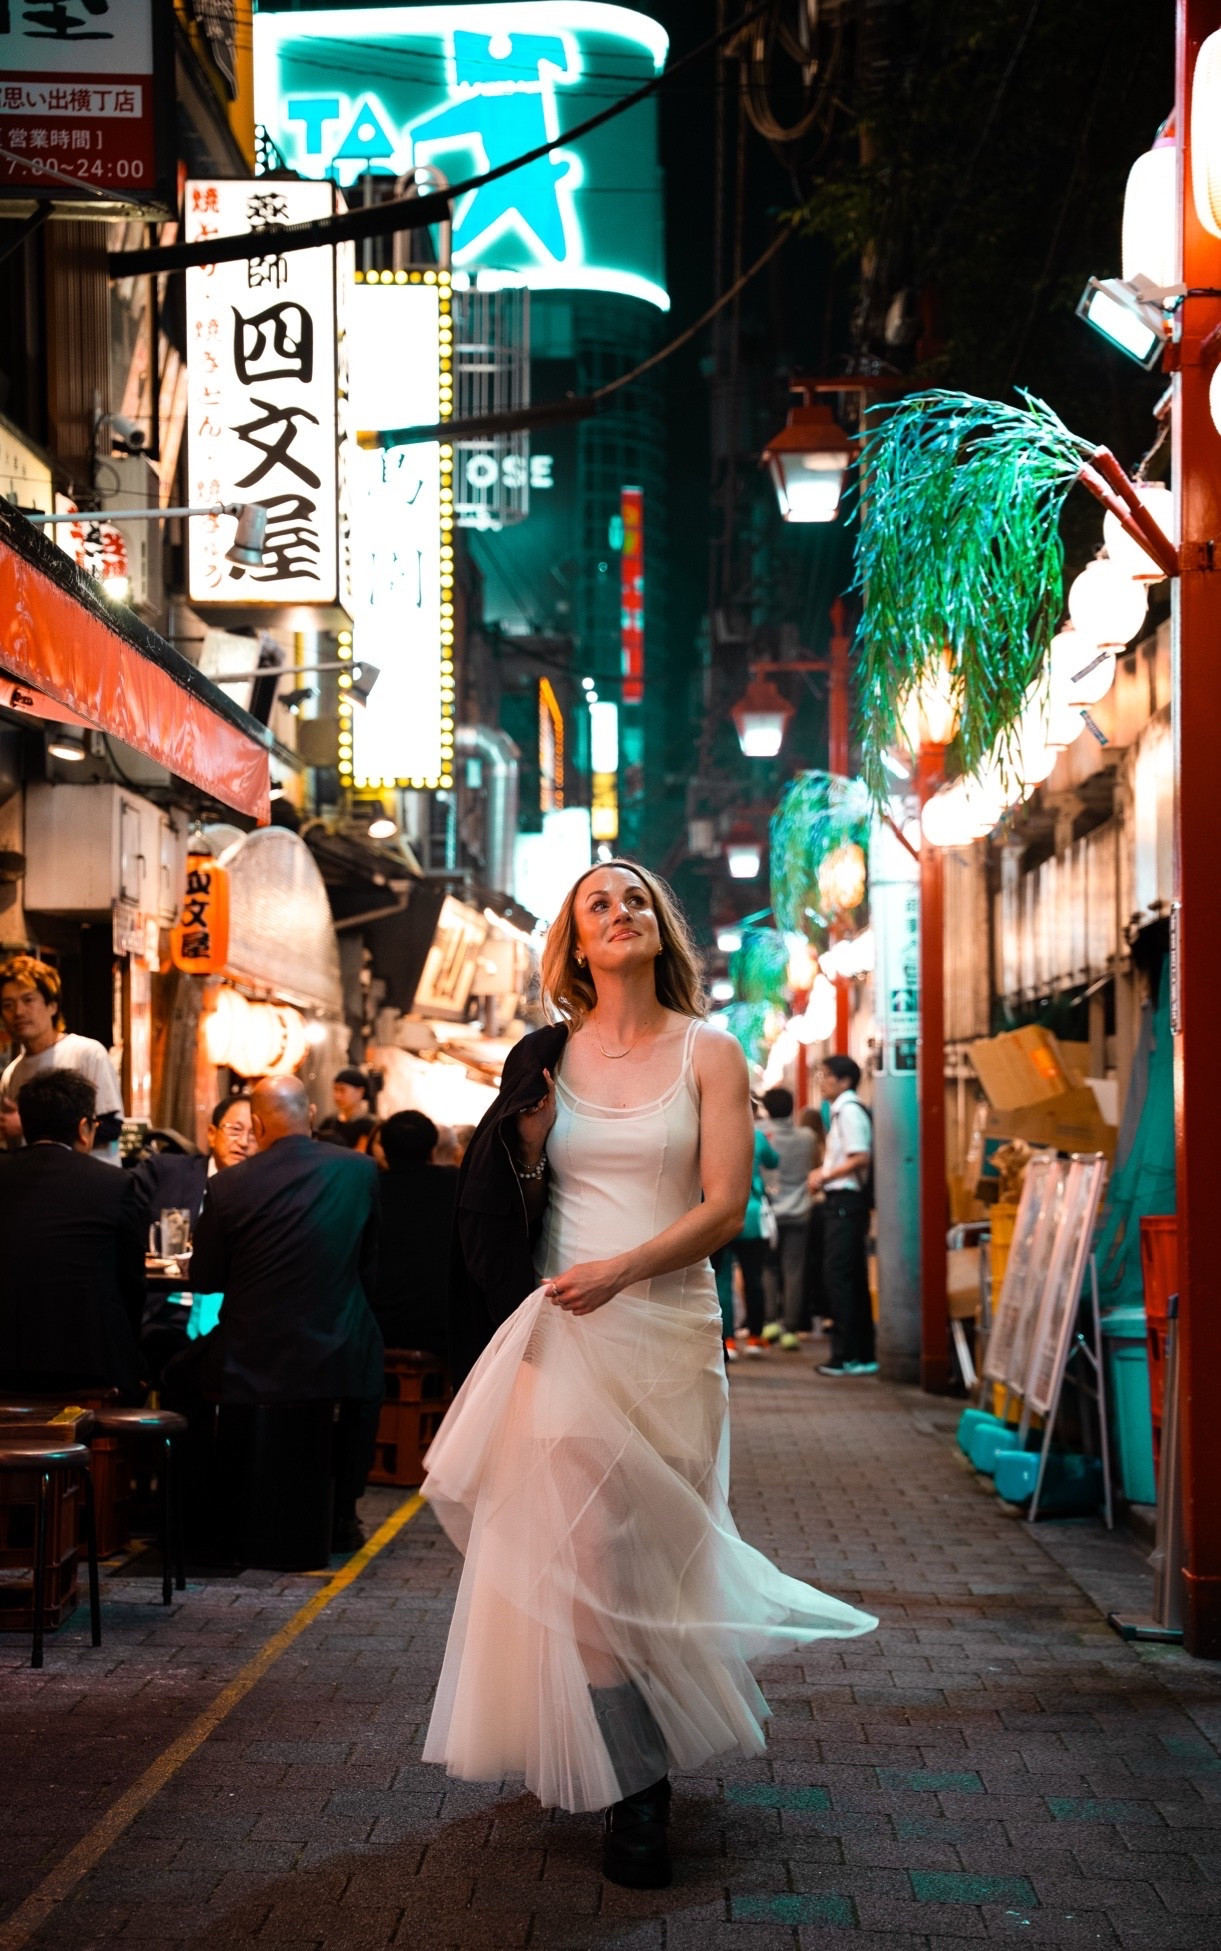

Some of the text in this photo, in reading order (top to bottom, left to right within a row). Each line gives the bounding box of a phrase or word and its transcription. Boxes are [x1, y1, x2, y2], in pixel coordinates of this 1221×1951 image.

[0, 88, 135, 112] 思い出横丁店
[228, 301, 322, 582] 四文屋
